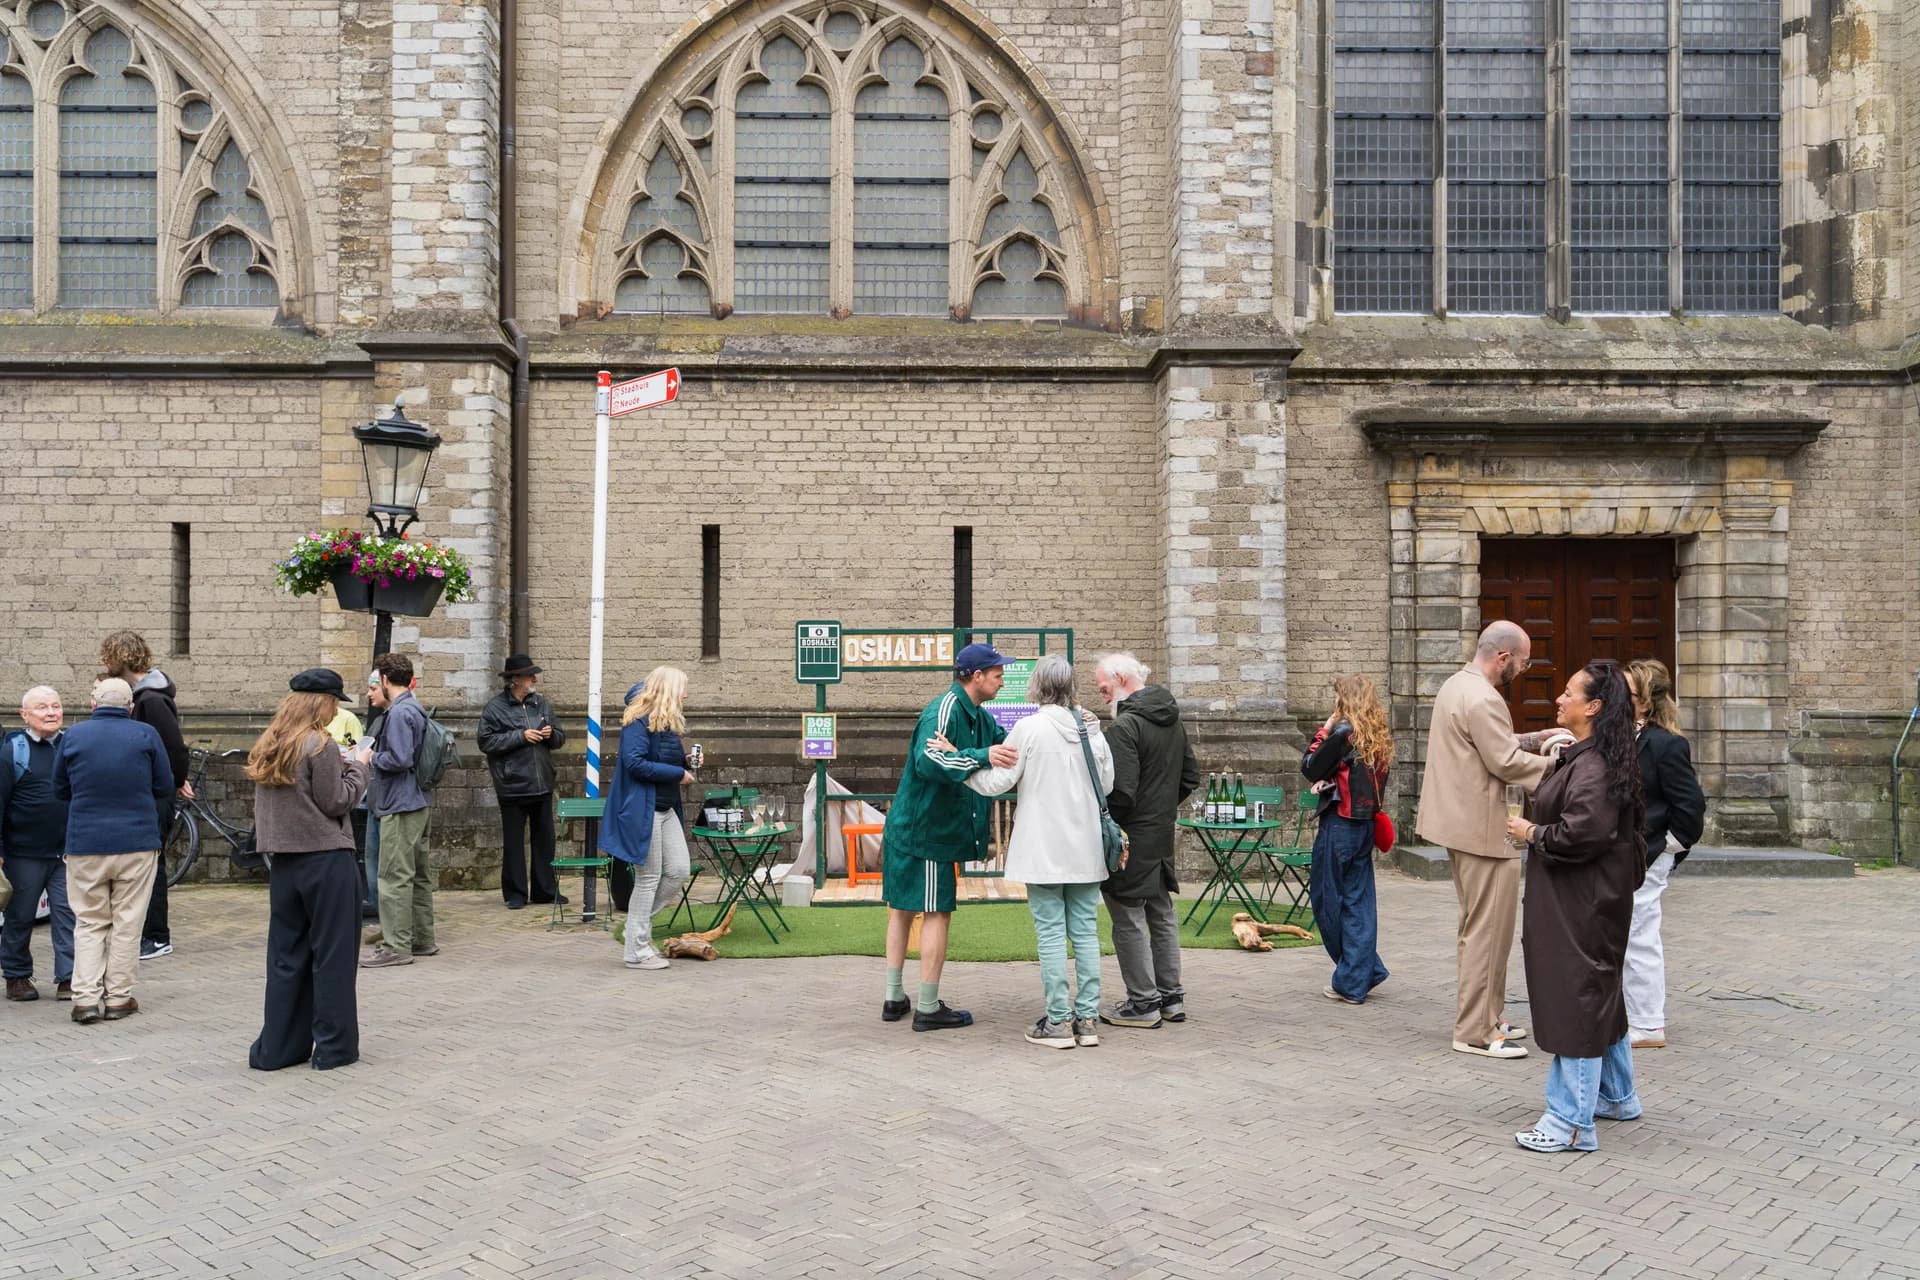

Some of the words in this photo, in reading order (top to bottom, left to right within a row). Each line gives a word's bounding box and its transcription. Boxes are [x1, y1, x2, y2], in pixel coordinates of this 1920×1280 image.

[620, 397, 640, 408] Neude
[801, 638, 837, 646] BOSHALTE
[844, 637, 952, 662] OSHALTE
[807, 717, 832, 728] BOS
